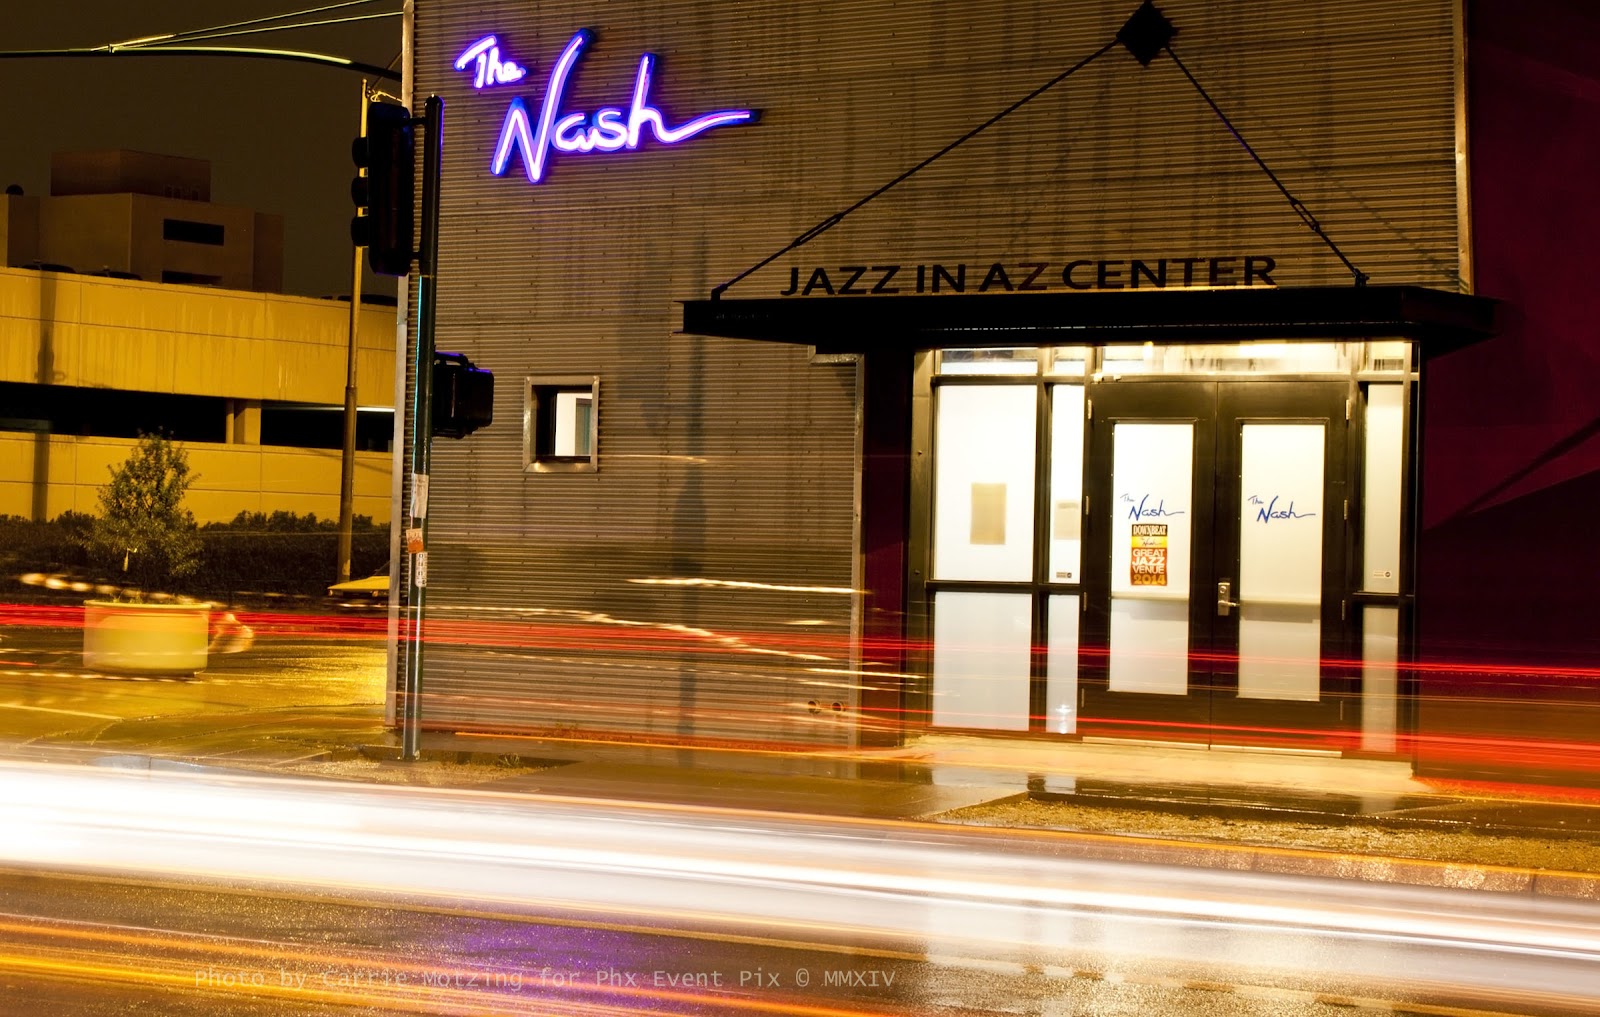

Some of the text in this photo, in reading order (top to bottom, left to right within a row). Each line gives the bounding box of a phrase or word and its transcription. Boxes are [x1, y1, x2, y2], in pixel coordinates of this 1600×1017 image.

[454, 33, 526, 89] The
[490, 28, 760, 184] Nash
[780, 255, 1277, 296] JAZZ IN AZ CENTER
[1128, 494, 1185, 521] Nash
[1248, 494, 1264, 505] The
[1257, 495, 1316, 524] Nash
[1131, 556, 1165, 566] JAZZ
[1132, 548, 1165, 557] GREAT
[1132, 565, 1165, 575] VENUE
[1133, 574, 1166, 585] 2014
